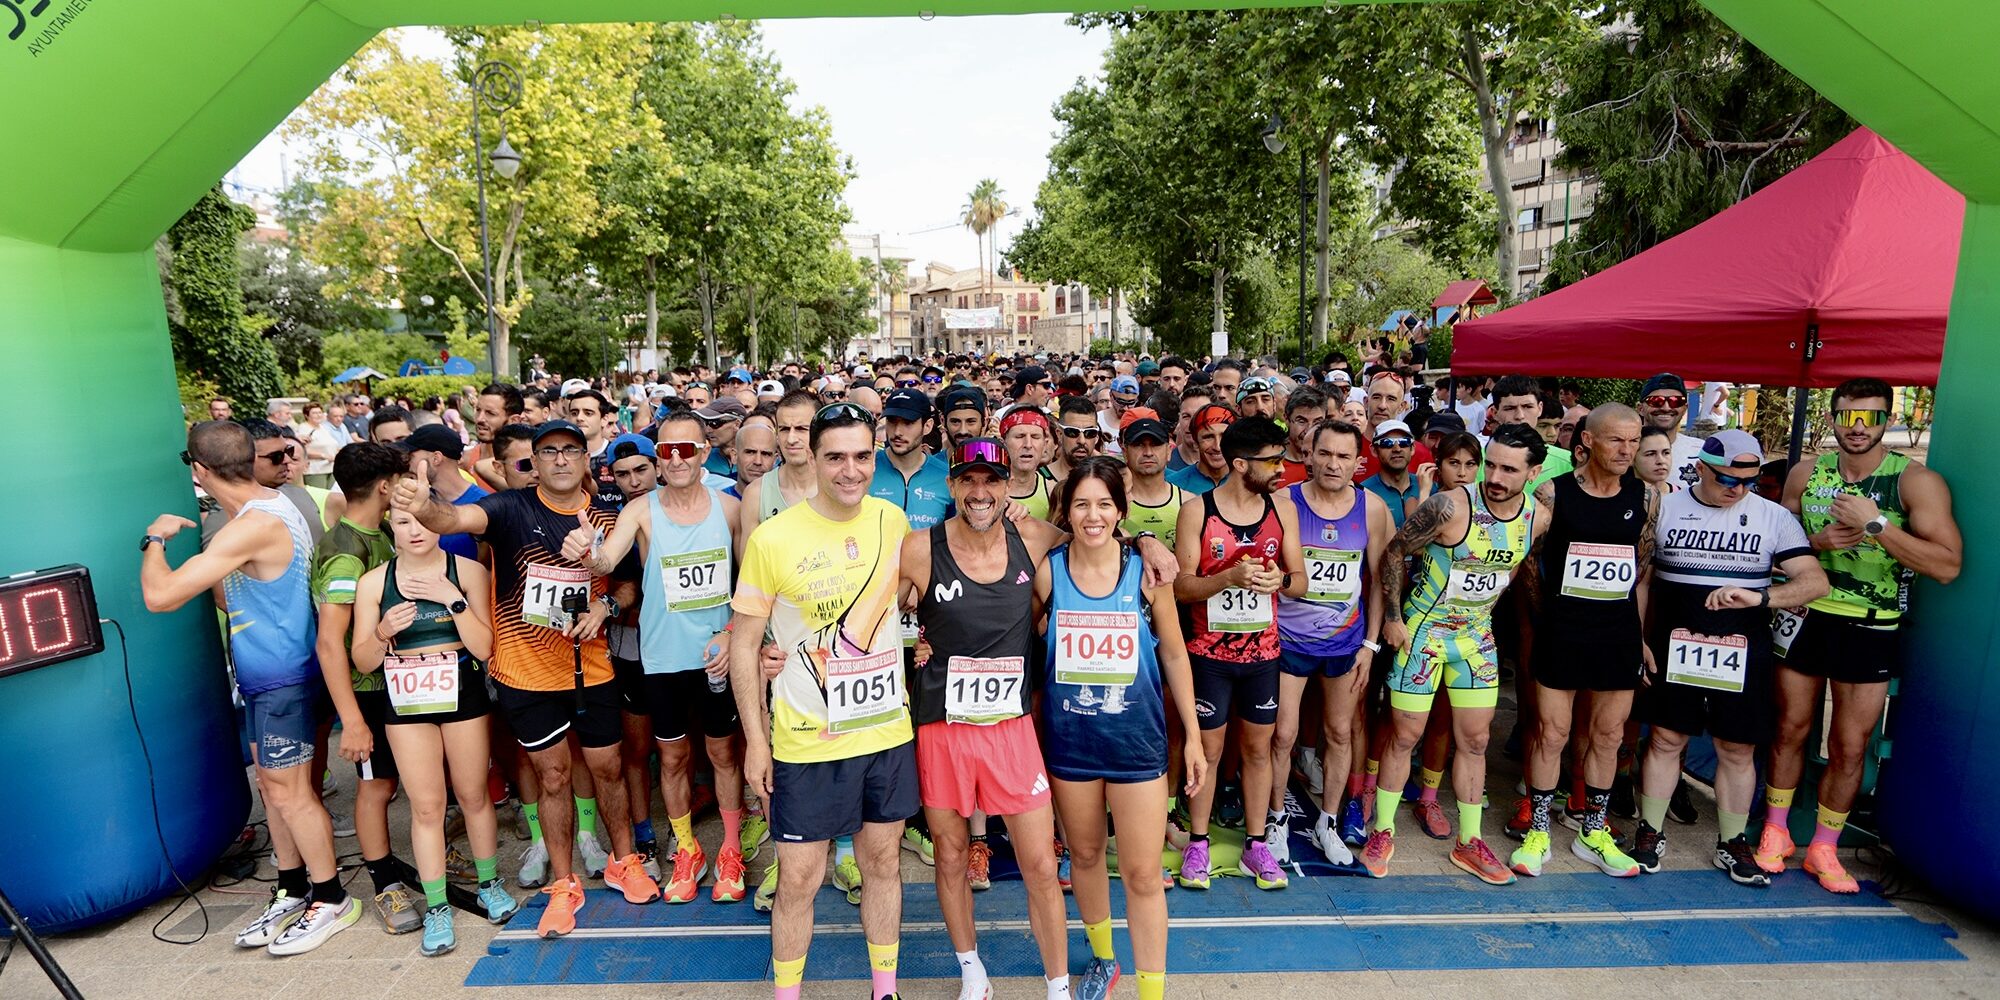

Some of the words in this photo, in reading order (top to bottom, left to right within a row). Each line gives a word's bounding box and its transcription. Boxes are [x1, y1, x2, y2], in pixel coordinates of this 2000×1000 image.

[1665, 528, 1762, 554] SPORTLAYO
[1683, 551, 1707, 559] CICLISMO
[679, 563, 716, 589] 507
[827, 574, 847, 586] CROSS
[1311, 561, 1347, 582] 240
[1462, 572, 1497, 592] 550
[1570, 559, 1632, 582] 1260
[817, 595, 844, 613] ALCALÁ
[1222, 589, 1258, 611] 313
[901, 612, 919, 628] 4
[1061, 632, 1135, 660] 1049
[1676, 644, 1740, 671] 1114
[391, 669, 455, 695] 1045
[833, 670, 896, 707] 1051
[952, 677, 1018, 703] 1197
